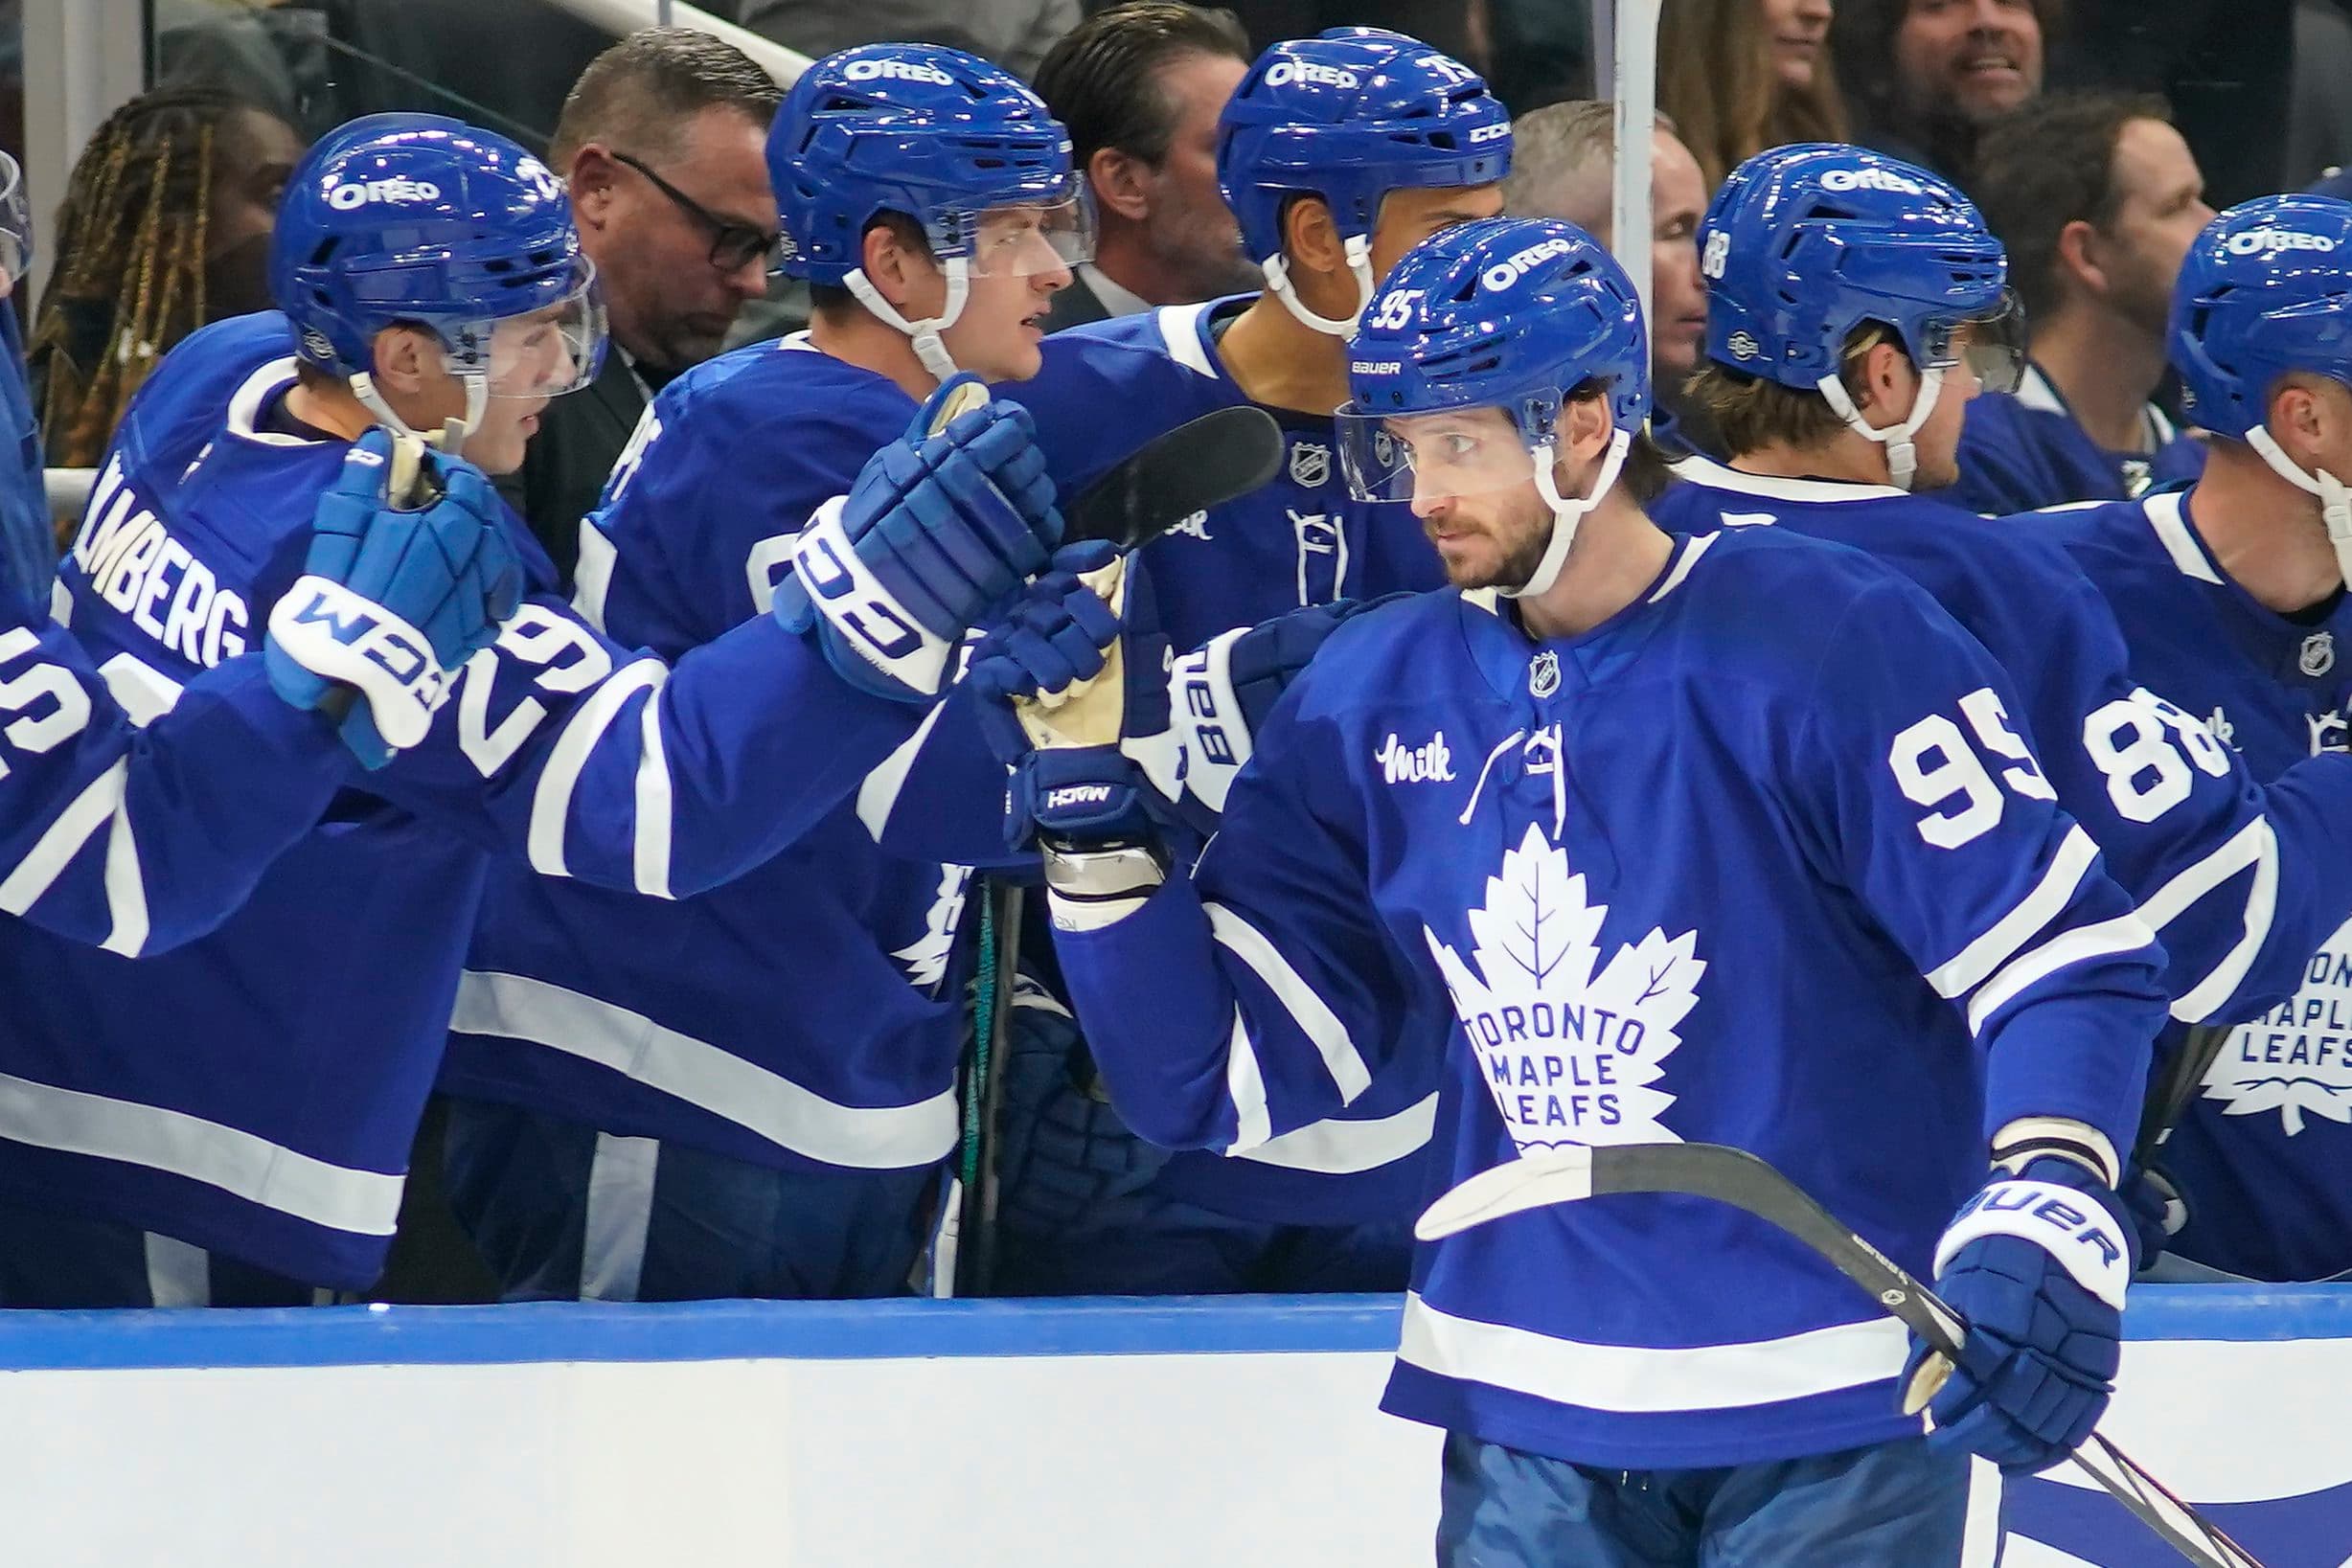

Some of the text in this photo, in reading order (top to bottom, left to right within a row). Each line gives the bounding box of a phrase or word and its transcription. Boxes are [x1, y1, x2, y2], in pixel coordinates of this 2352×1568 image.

[844, 57, 953, 86] OREO
[1265, 61, 1359, 88] OREO
[329, 177, 441, 210] OREO
[2228, 229, 2335, 255] OREO
[1482, 238, 1571, 291] OREO
[1372, 289, 1425, 330] 95
[1374, 730, 1457, 784] Milk
[1888, 687, 2059, 850] 95
[2083, 687, 2231, 824] 88
[1047, 785, 1110, 808] MACH
[1461, 1002, 1655, 1056] TORONTO
[2261, 998, 2352, 1031] APL
[1490, 1053, 1617, 1087] MAPLE
[1497, 1093, 1622, 1126] LEAFS
